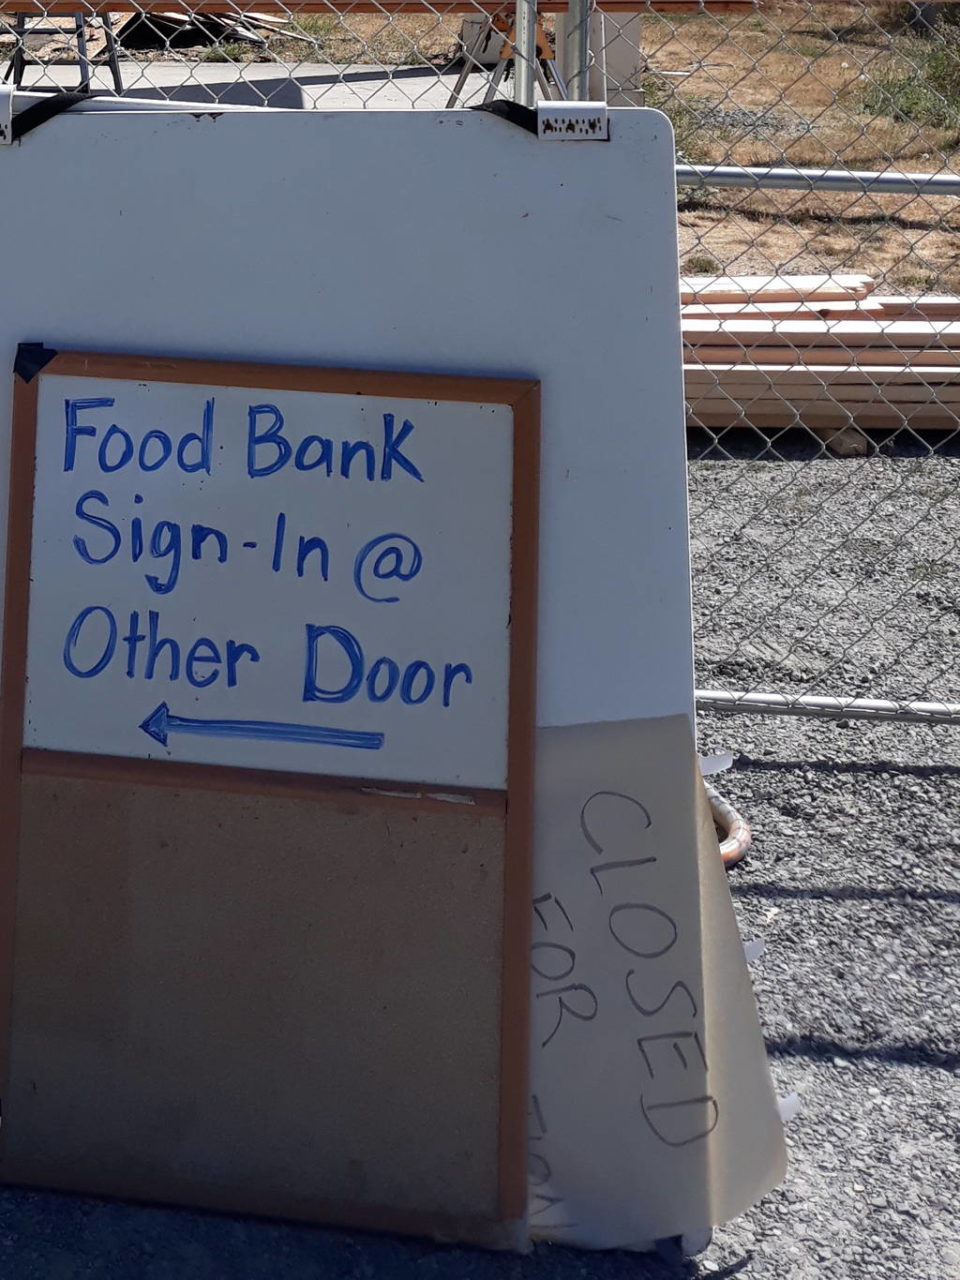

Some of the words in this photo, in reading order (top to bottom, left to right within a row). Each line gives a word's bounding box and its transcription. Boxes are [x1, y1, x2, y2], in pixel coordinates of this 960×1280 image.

[63, 397, 215, 476] Food
[73, 490, 329, 594] Sign-In
[353, 532, 423, 603] @
[63, 605, 260, 689] Other
[303, 623, 473, 707] Door
[531, 893, 598, 1048] FOR
[580, 791, 719, 1147] CLOSED
